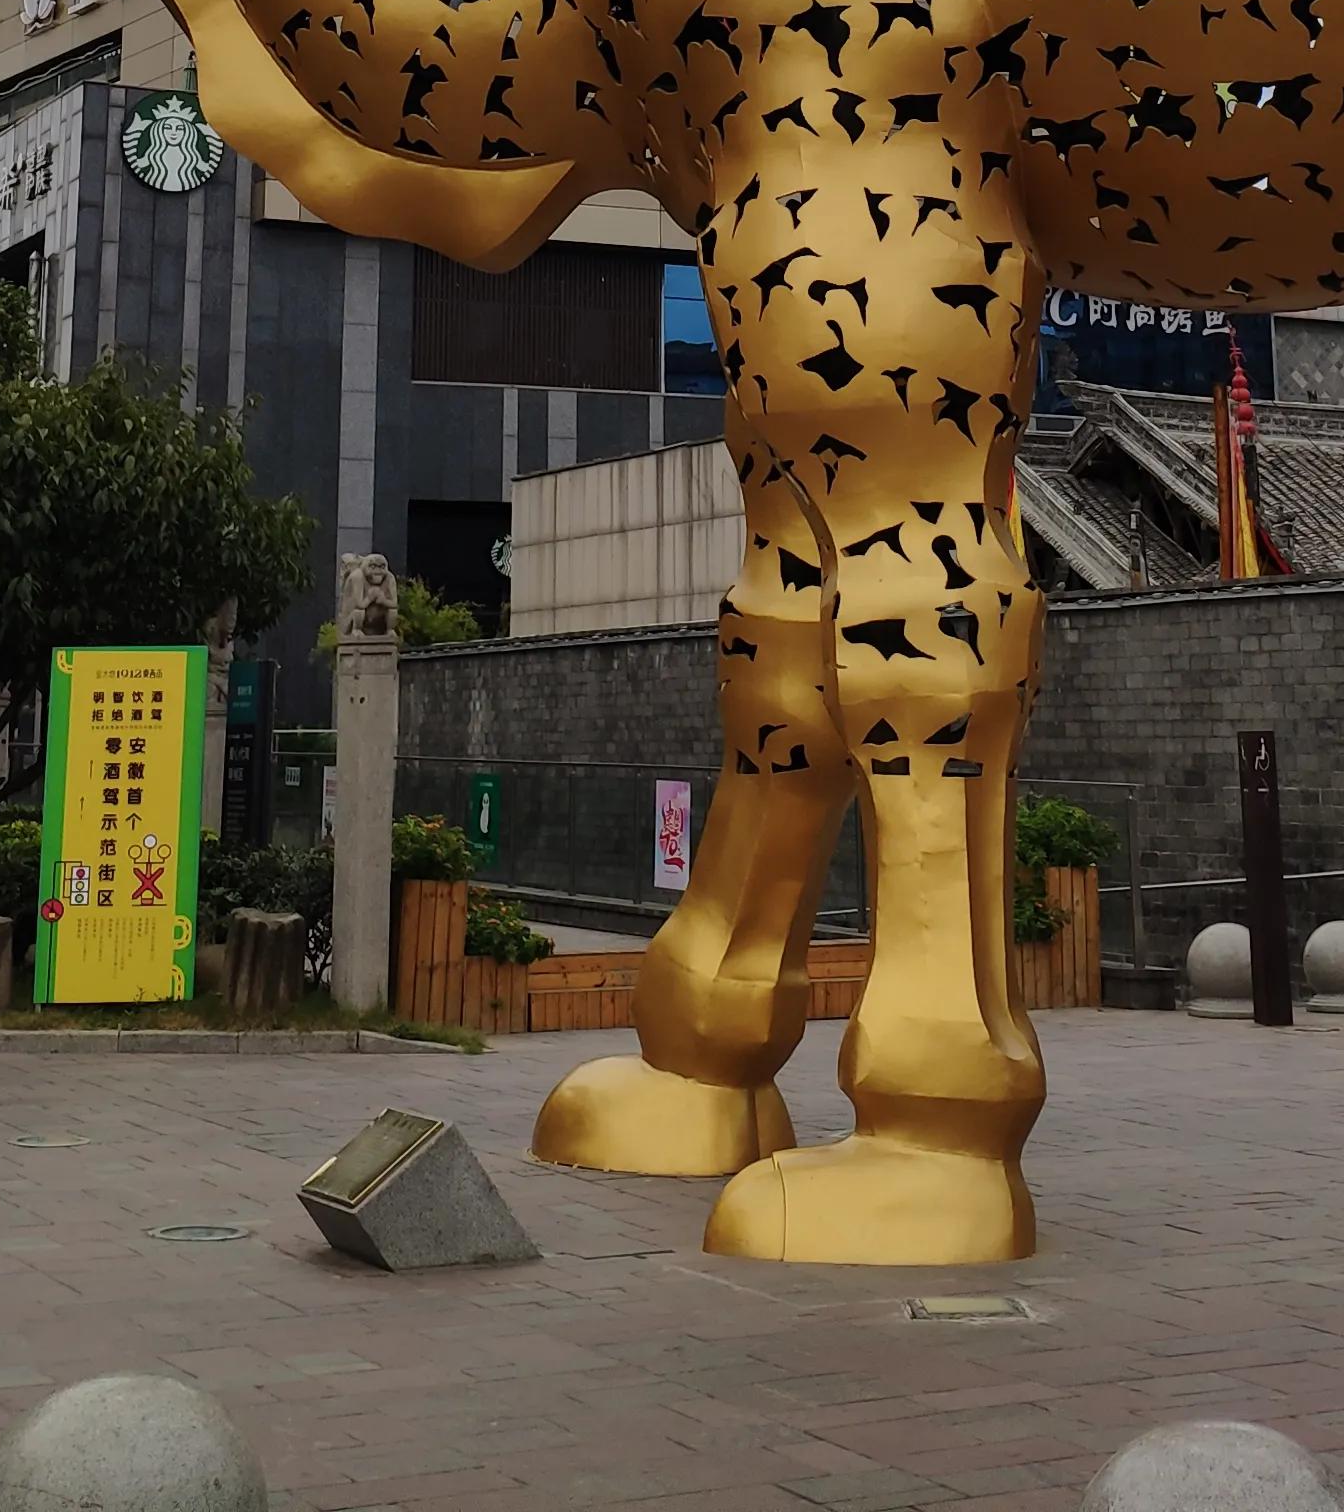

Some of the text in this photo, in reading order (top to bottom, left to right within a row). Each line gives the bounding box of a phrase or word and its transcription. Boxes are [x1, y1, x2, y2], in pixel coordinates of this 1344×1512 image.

[97, 737, 122, 907] 零酒驾示范街区
